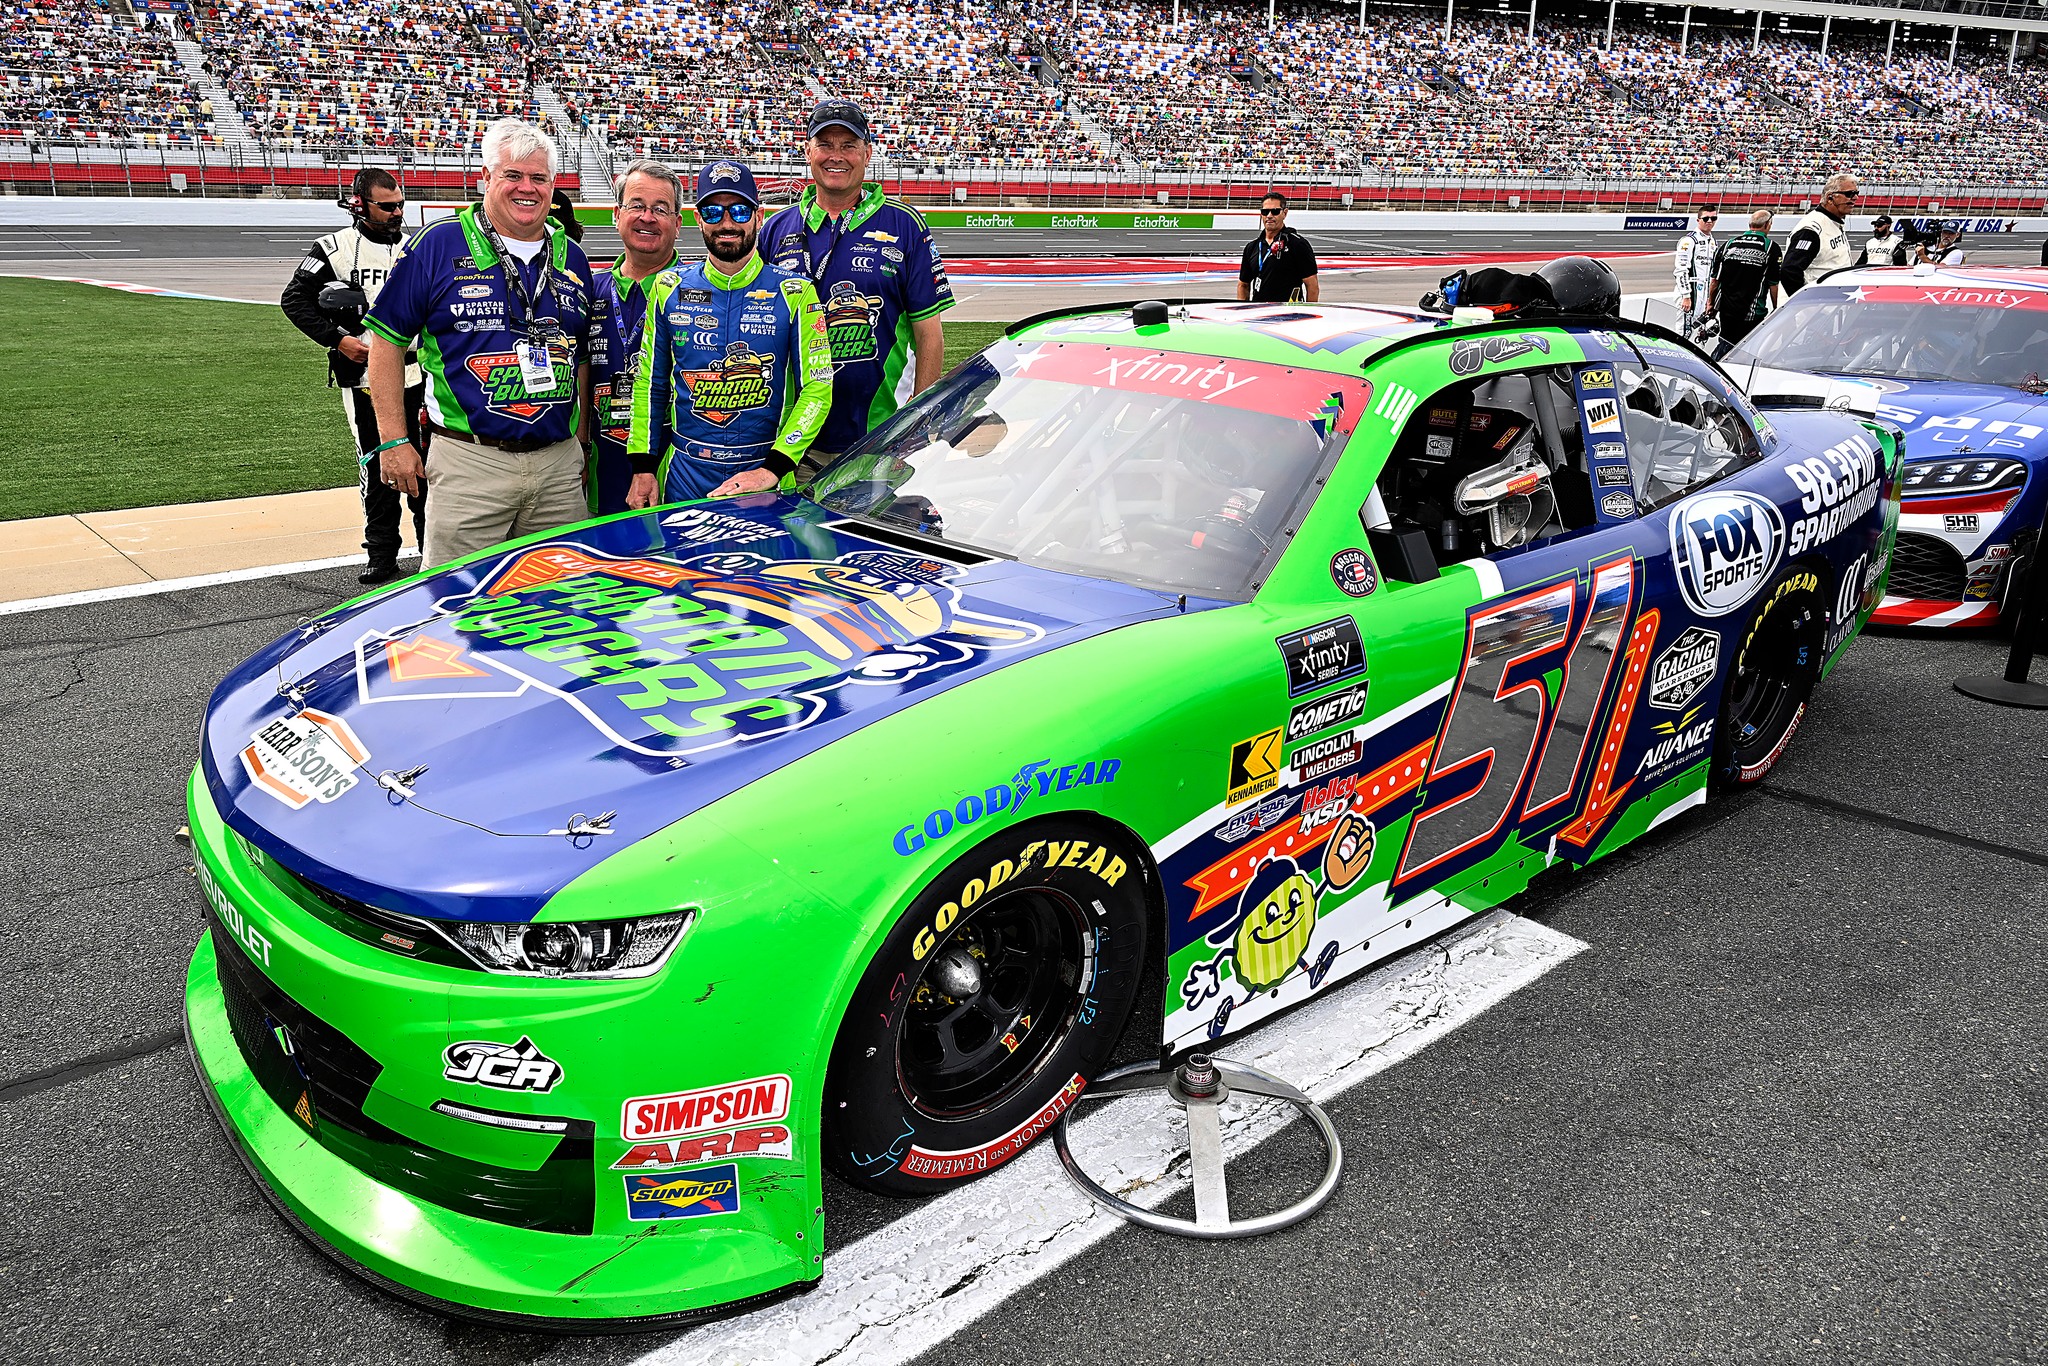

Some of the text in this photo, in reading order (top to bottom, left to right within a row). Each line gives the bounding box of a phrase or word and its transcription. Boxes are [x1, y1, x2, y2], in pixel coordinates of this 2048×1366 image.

[966, 214, 1014, 227] EchoPark
[1051, 216, 1098, 228] EchoPark
[1133, 216, 1179, 228] EchoPark
[1975, 219, 2003, 232] USA
[459, 257, 475, 268] xfin
[466, 307, 504, 316] WASTE
[675, 304, 713, 313] GOODYEAR
[684, 293, 707, 302] xfinity
[1919, 288, 2031, 308] xfinity
[829, 325, 870, 341] RTAN
[831, 338, 876, 357] GERS
[693, 378, 763, 396] SPARTAN
[1093, 354, 1259, 400] xfinity
[694, 389, 769, 408] BURGERS
[1587, 401, 1616, 423] WIX
[1598, 466, 1628, 476] MatMan
[1784, 434, 1876, 514] 98.3FM
[706, 511, 790, 539] SPARTAN
[1788, 478, 1881, 557] SPARTANBURG
[1945, 515, 1978, 527] SHR
[685, 524, 770, 545] WASTE
[1689, 504, 1763, 572] FOX
[1334, 552, 1365, 572] NASCAR
[1703, 556, 1764, 595] SPORTS
[1343, 574, 1375, 593] SALUTES
[1310, 627, 1337, 645] NASCAR
[1680, 632, 1698, 648] THE
[1829, 614, 1858, 653] CLAYTON
[1299, 641, 1350, 678] xfinity
[1658, 640, 1715, 682] RACING
[1317, 666, 1339, 682] SERIES
[1656, 662, 1713, 692] WAREHOUSE
[1659, 691, 1671, 700] SINCE
[1289, 689, 1366, 736] COMETIC
[1392, 555, 1634, 887] 51
[1292, 724, 1323, 740] GASKET
[1778, 718, 1800, 753] HONOR
[257, 721, 352, 799] HARRISON'S
[1294, 733, 1351, 768] LINCOLN
[1635, 718, 1715, 776] ALLIANCE
[1675, 747, 1705, 767] SOLUTIONS
[1305, 750, 1356, 779] WELDERS
[1741, 757, 1772, 780] REMEMBER
[1228, 776, 1277, 805] KENNAMETAL
[1302, 773, 1359, 813] Holley
[892, 758, 1121, 857] GOODYEAR
[1228, 798, 1285, 832] FIVE STAR
[1299, 798, 1349, 834] MSD
[191, 838, 273, 968] CHEVROLET
[912, 839, 1128, 961] GOODYEAR
[1079, 997, 1099, 1025] LF2
[446, 1052, 556, 1089] JCR
[635, 1083, 778, 1135] SIMPSON
[615, 1125, 789, 1166] ARP
[907, 1094, 1069, 1173] HONOR AND REMEMBER
[673, 1158, 704, 1167] Products
[707, 1153, 741, 1161] Professional
[636, 1181, 727, 1201] SUNOCO
